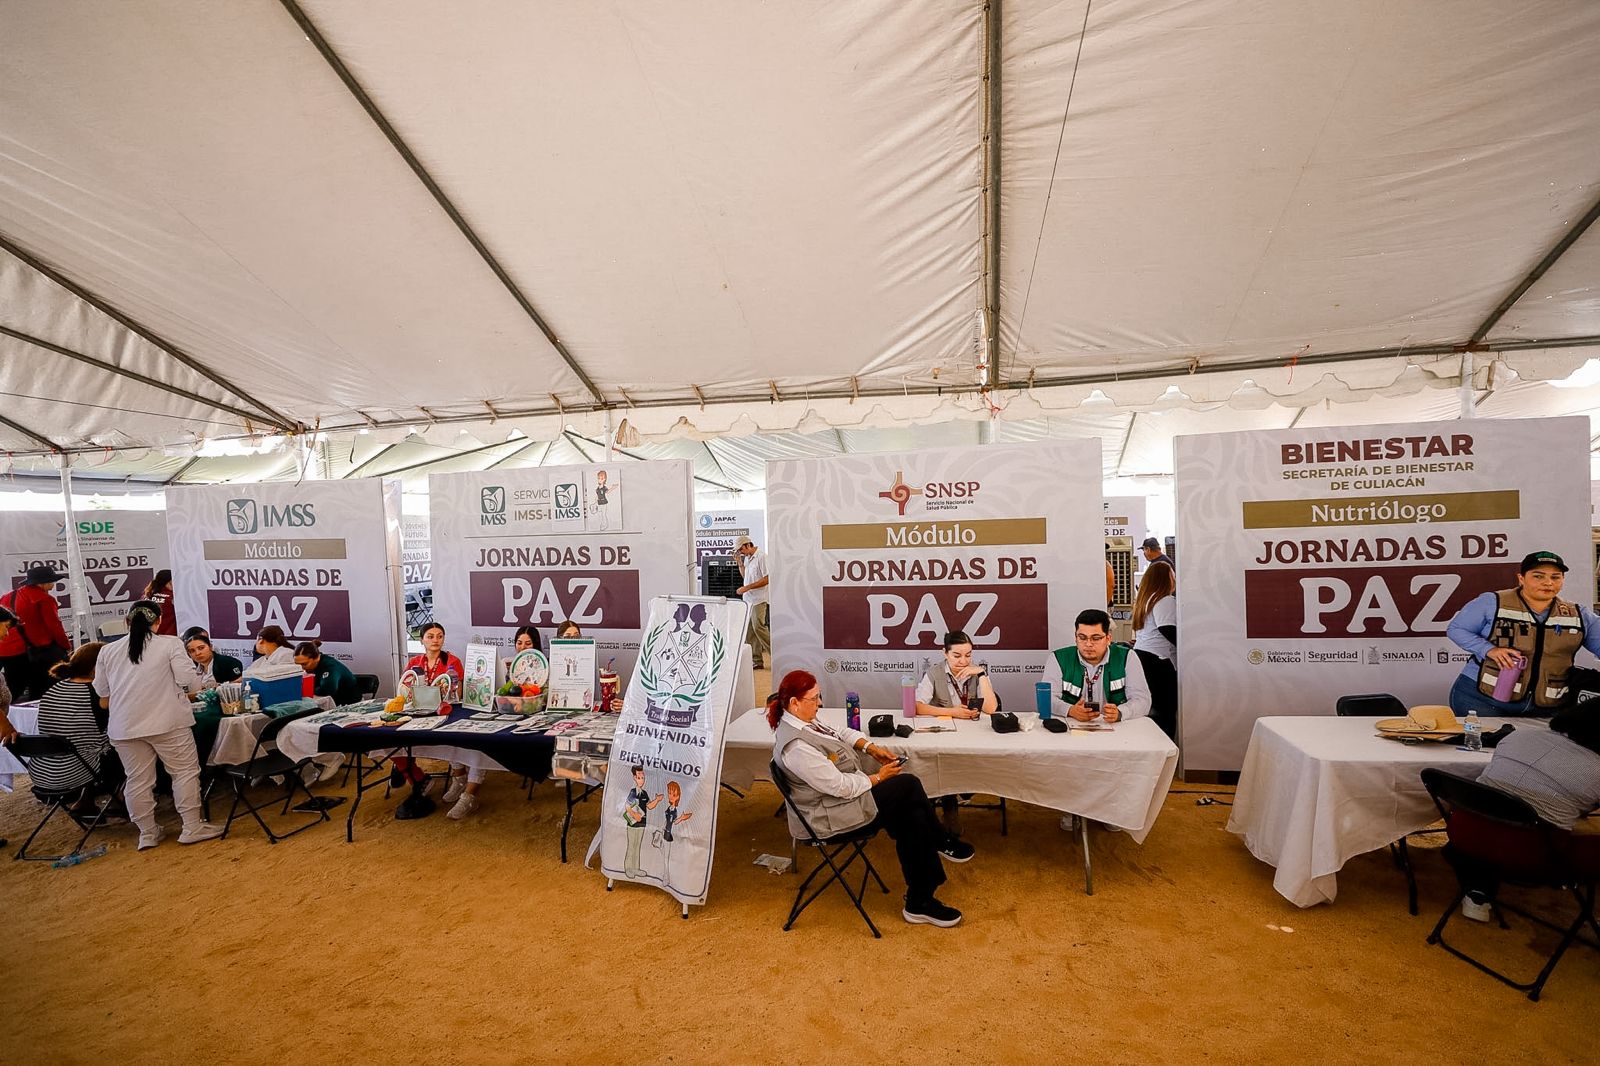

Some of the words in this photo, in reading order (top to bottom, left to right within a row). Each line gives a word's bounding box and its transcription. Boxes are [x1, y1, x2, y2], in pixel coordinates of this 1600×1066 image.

[1281, 434, 1474, 465] BIENESTAR
[1282, 465, 1368, 480] SECRETARÍA
[1372, 466, 1391, 475] DE
[1396, 462, 1474, 474] BIENESTAR
[925, 482, 980, 498] SNSP
[1330, 482, 1350, 490] DE
[1354, 476, 1425, 490] CULIACÁN
[514, 489, 550, 500] SERVICI
[262, 503, 316, 528] IMSS
[480, 513, 507, 526] IMSS
[555, 508, 580, 520] IMSS
[1312, 501, 1447, 524] Nutriólogo
[886, 524, 976, 546] Módulo
[1112, 528, 1126, 536] DE
[244, 542, 302, 559] Módulo
[402, 552, 429, 561] RNADAS
[476, 546, 591, 568] JORNADAS
[600, 546, 631, 566] DE
[1256, 535, 1447, 564] JORNADAS
[1460, 534, 1509, 558] DE
[18, 557, 120, 573] JORNDAS
[127, 556, 149, 567] DE
[403, 563, 432, 583] PAZ
[832, 558, 986, 582] JORNADAS
[998, 556, 1038, 580] DE
[212, 568, 310, 586] JORNADAS
[316, 568, 342, 586] DE
[502, 576, 603, 624] PAZ
[1299, 574, 1462, 634] PAZ
[234, 595, 321, 638] PAZ
[866, 592, 1000, 646] PAZ
[1308, 651, 1358, 660] Seguridad
[1382, 652, 1424, 660] SINALOA
[840, 664, 868, 672] México
[874, 662, 914, 670] Seguridad
[626, 724, 706, 748] BIENVENIDAS
[619, 750, 702, 778] BIENVENIDOS
